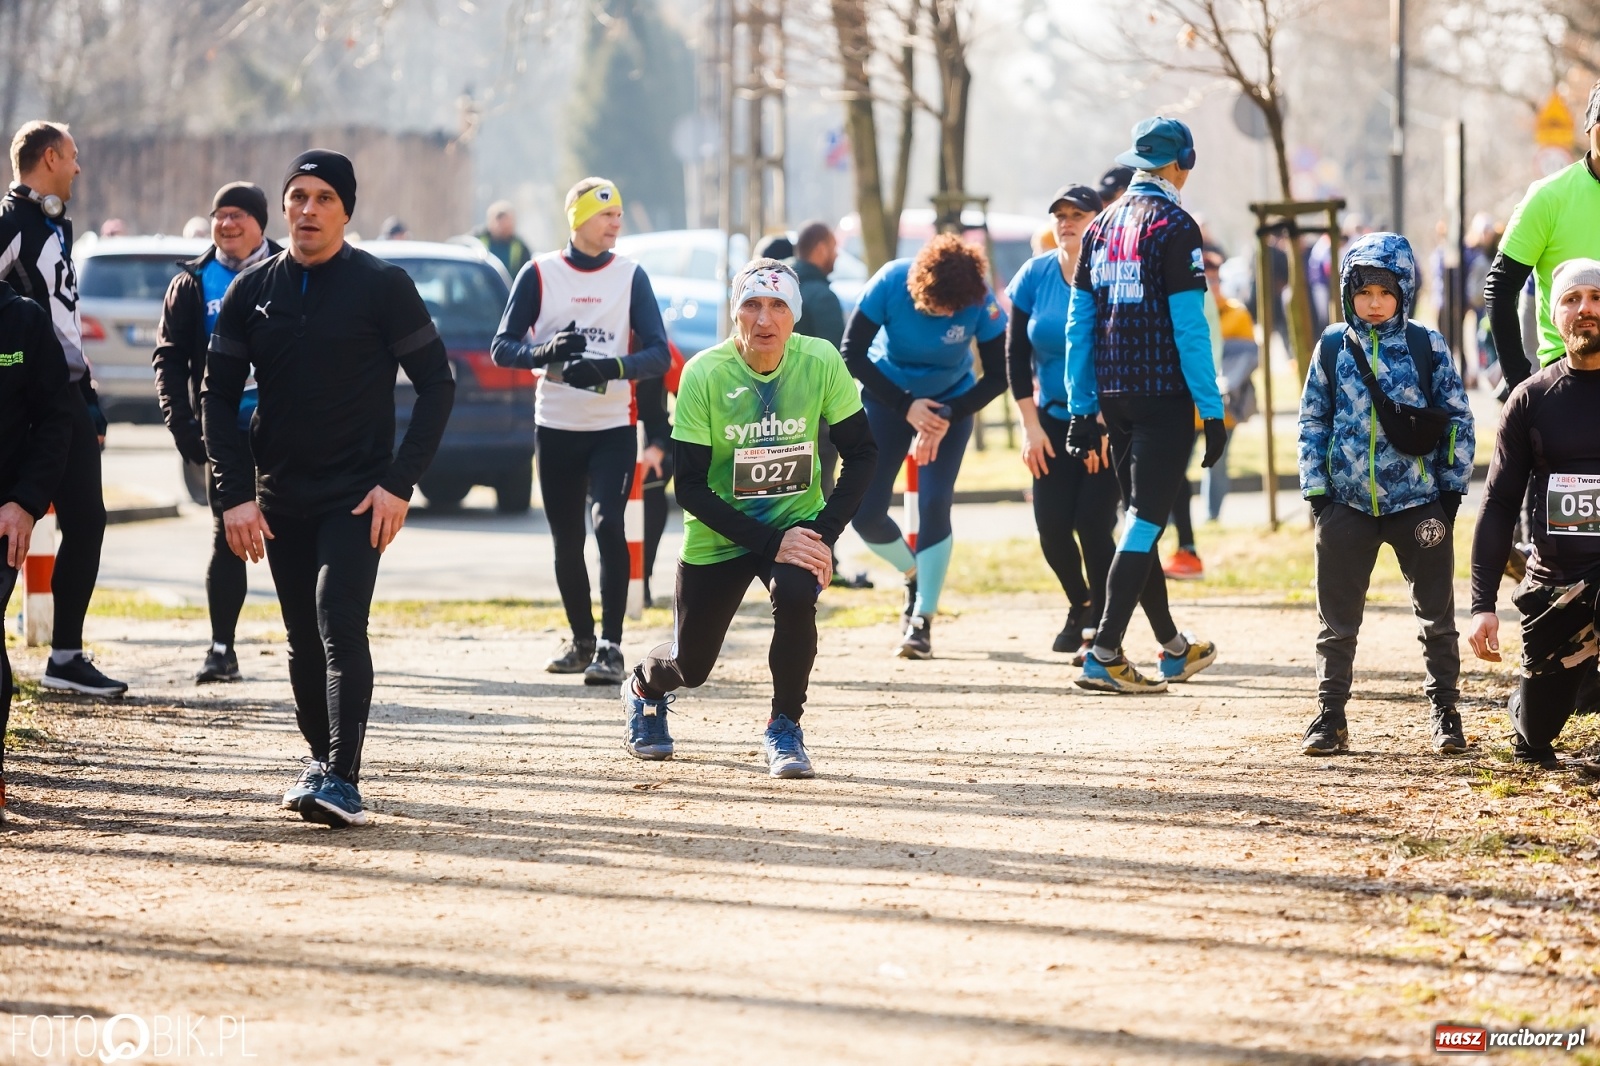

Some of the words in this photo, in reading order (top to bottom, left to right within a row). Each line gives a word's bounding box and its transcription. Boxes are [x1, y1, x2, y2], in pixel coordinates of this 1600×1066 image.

[725, 412, 806, 444] synthos
[749, 436, 775, 444] chemical
[776, 433, 807, 441] innovations
[766, 445, 805, 455] Twardziela
[750, 461, 798, 483] 027
